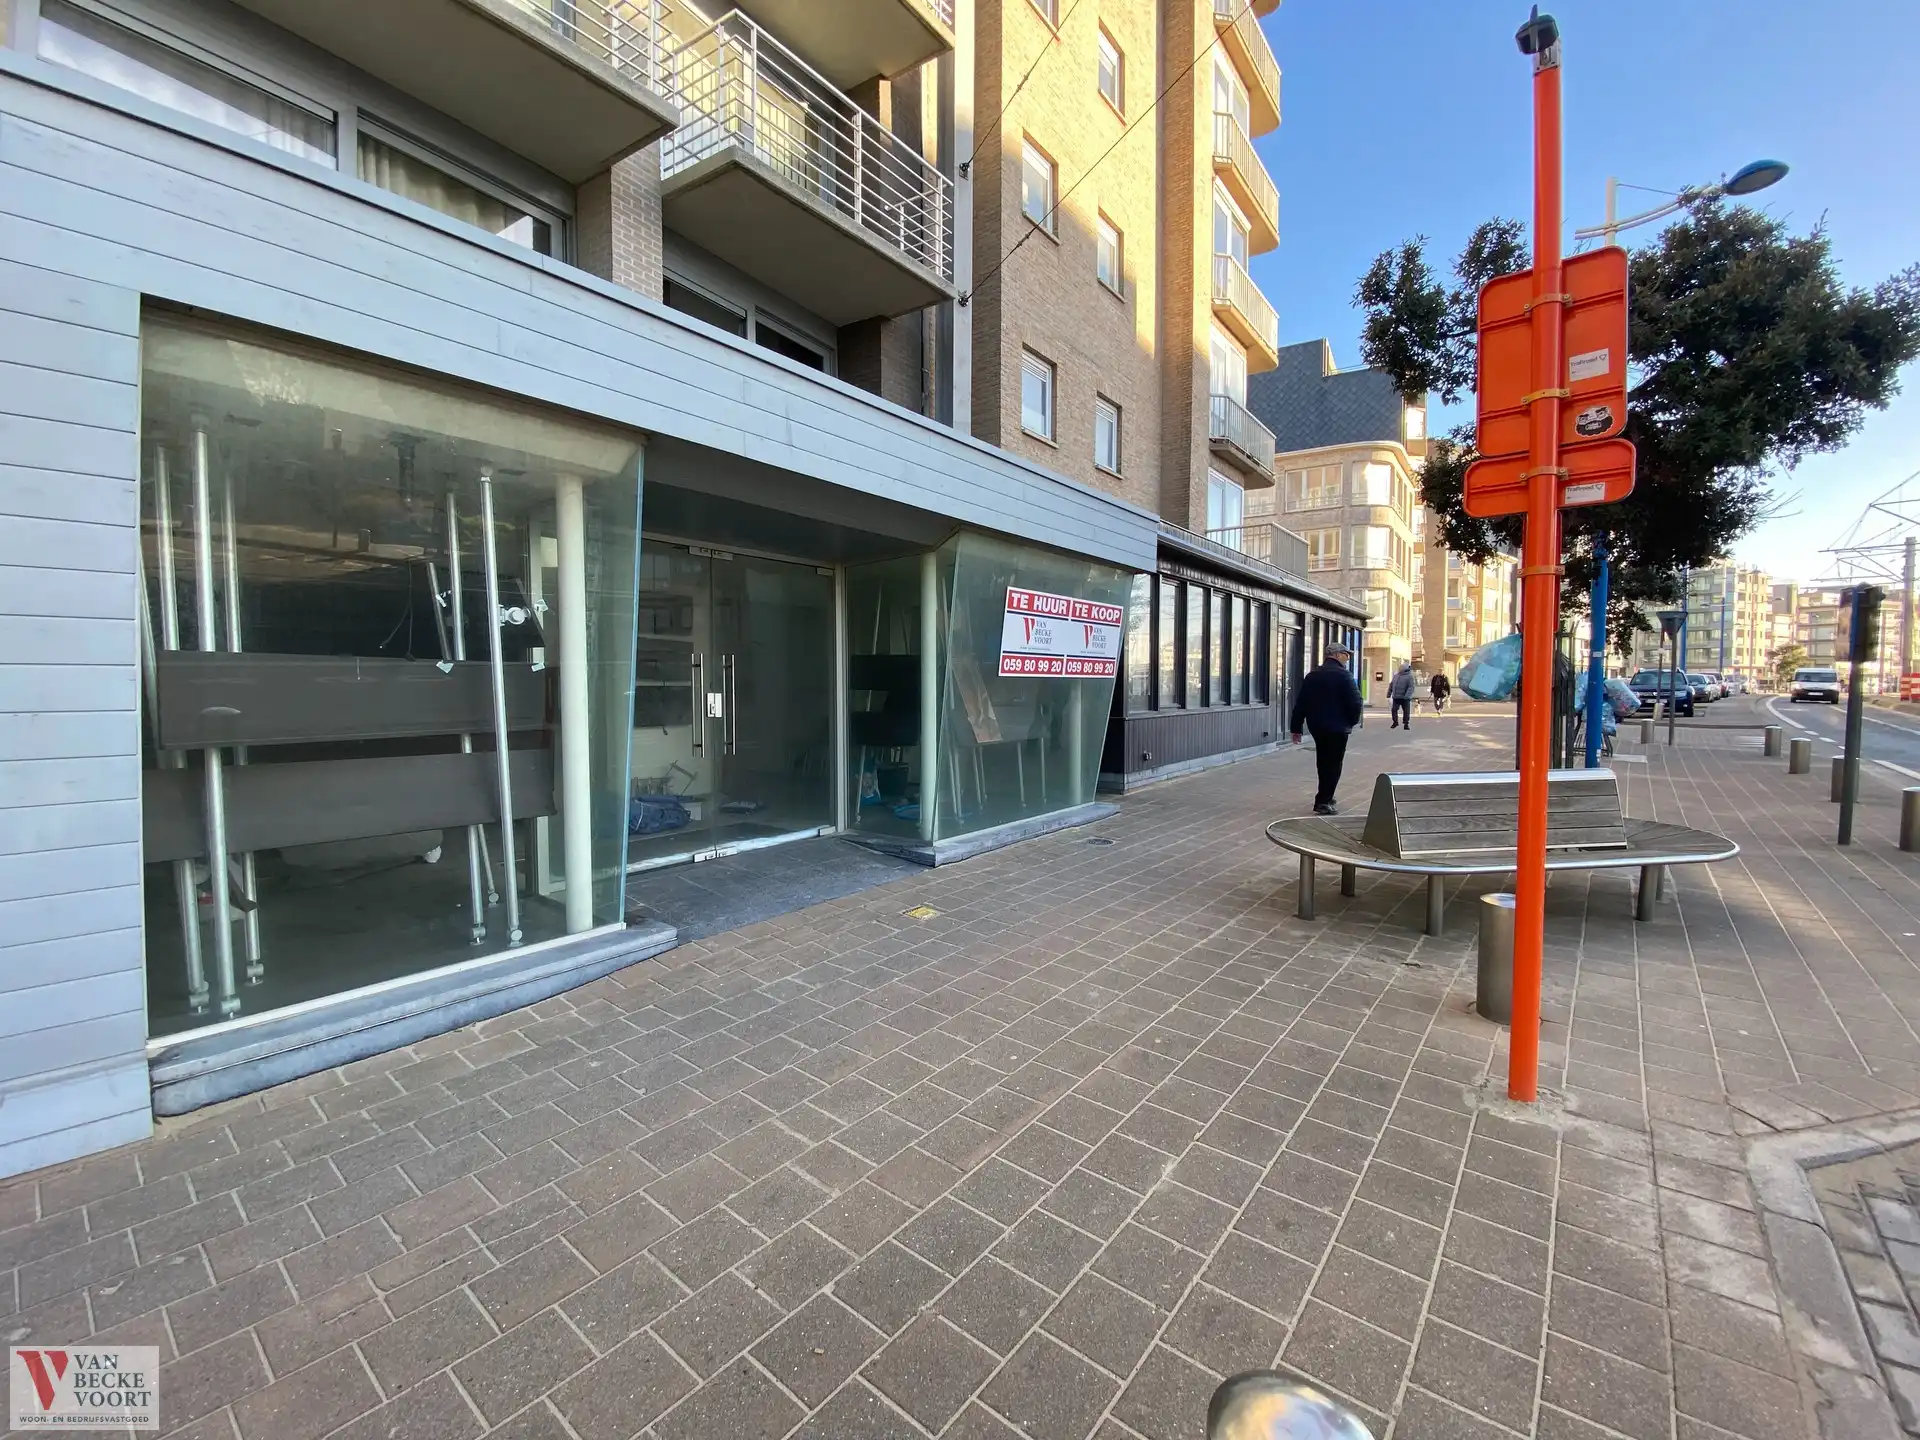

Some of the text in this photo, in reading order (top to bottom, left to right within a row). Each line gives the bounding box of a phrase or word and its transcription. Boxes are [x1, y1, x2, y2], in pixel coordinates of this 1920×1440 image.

[1011, 592, 1068, 615] TE HUUR
[1074, 603, 1120, 621] TE KOOP
[1034, 629, 1052, 637] BECKE
[1034, 637, 1052, 645] VOORT
[1004, 658, 1062, 673] 059 80 99 20
[1067, 661, 1114, 674] 059 80 99 20
